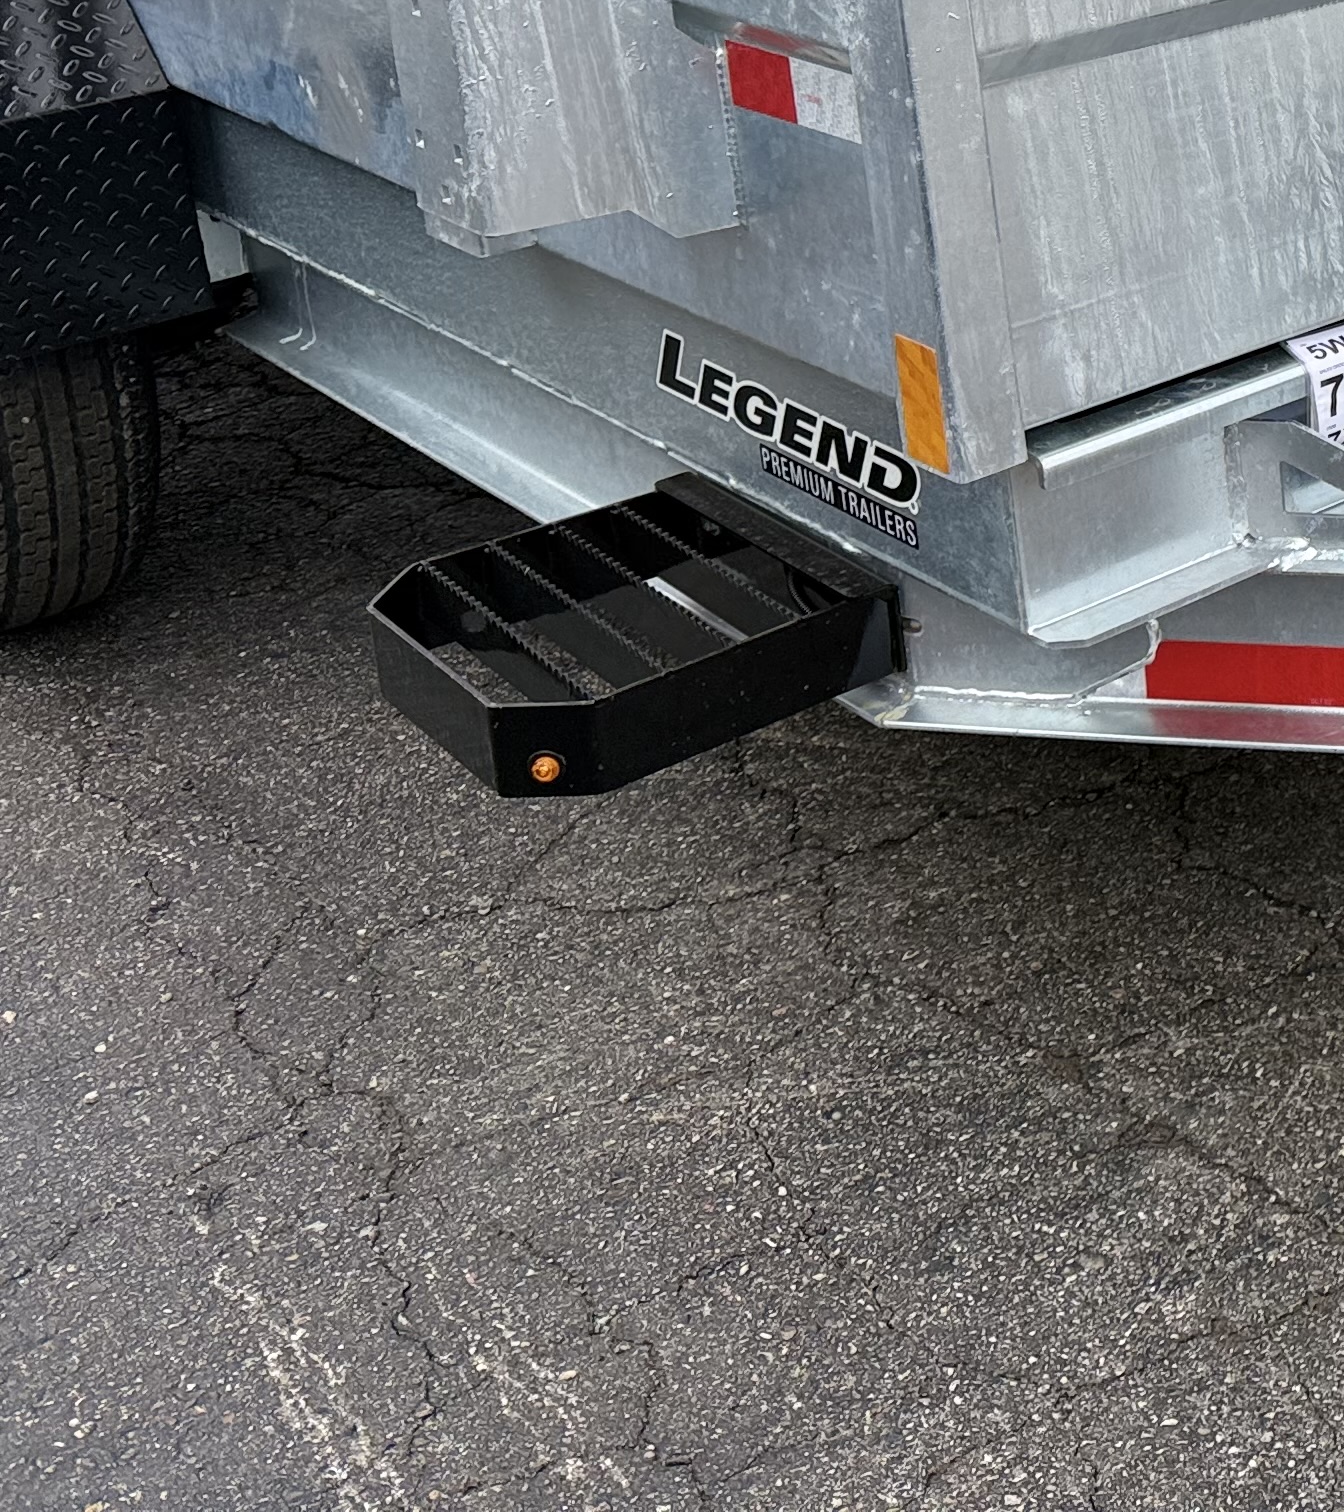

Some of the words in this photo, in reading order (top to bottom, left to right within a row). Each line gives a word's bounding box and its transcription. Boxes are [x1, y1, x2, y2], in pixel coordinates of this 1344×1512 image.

[656, 328, 922, 509] LEGEND
[761, 445, 836, 508] PREMIUM
[838, 484, 919, 549] TRAILERS
